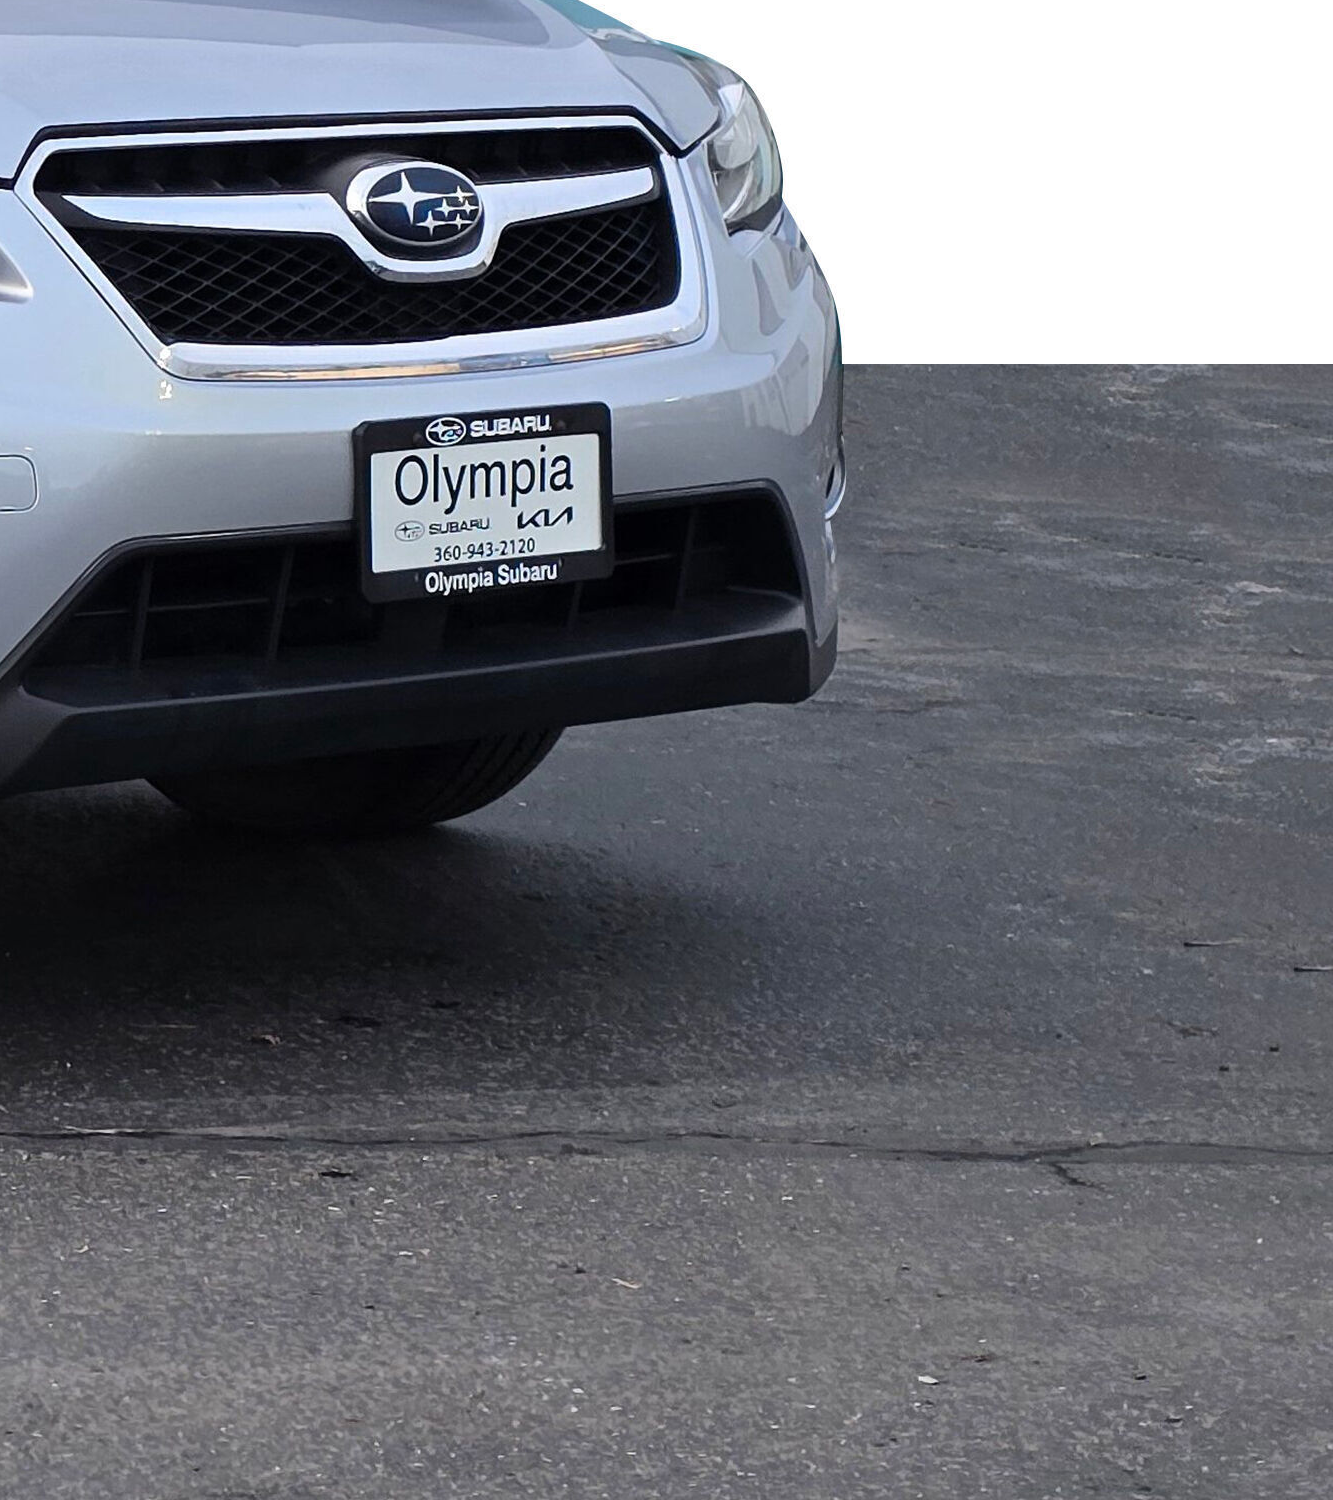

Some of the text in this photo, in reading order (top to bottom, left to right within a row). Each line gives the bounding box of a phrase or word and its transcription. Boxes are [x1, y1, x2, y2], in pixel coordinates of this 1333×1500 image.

[394, 444, 574, 516] Olympia
[428, 517, 491, 536] SUBARU
[433, 537, 536, 563] 360-943-2120
[424, 562, 558, 596] Olympia Subaru
